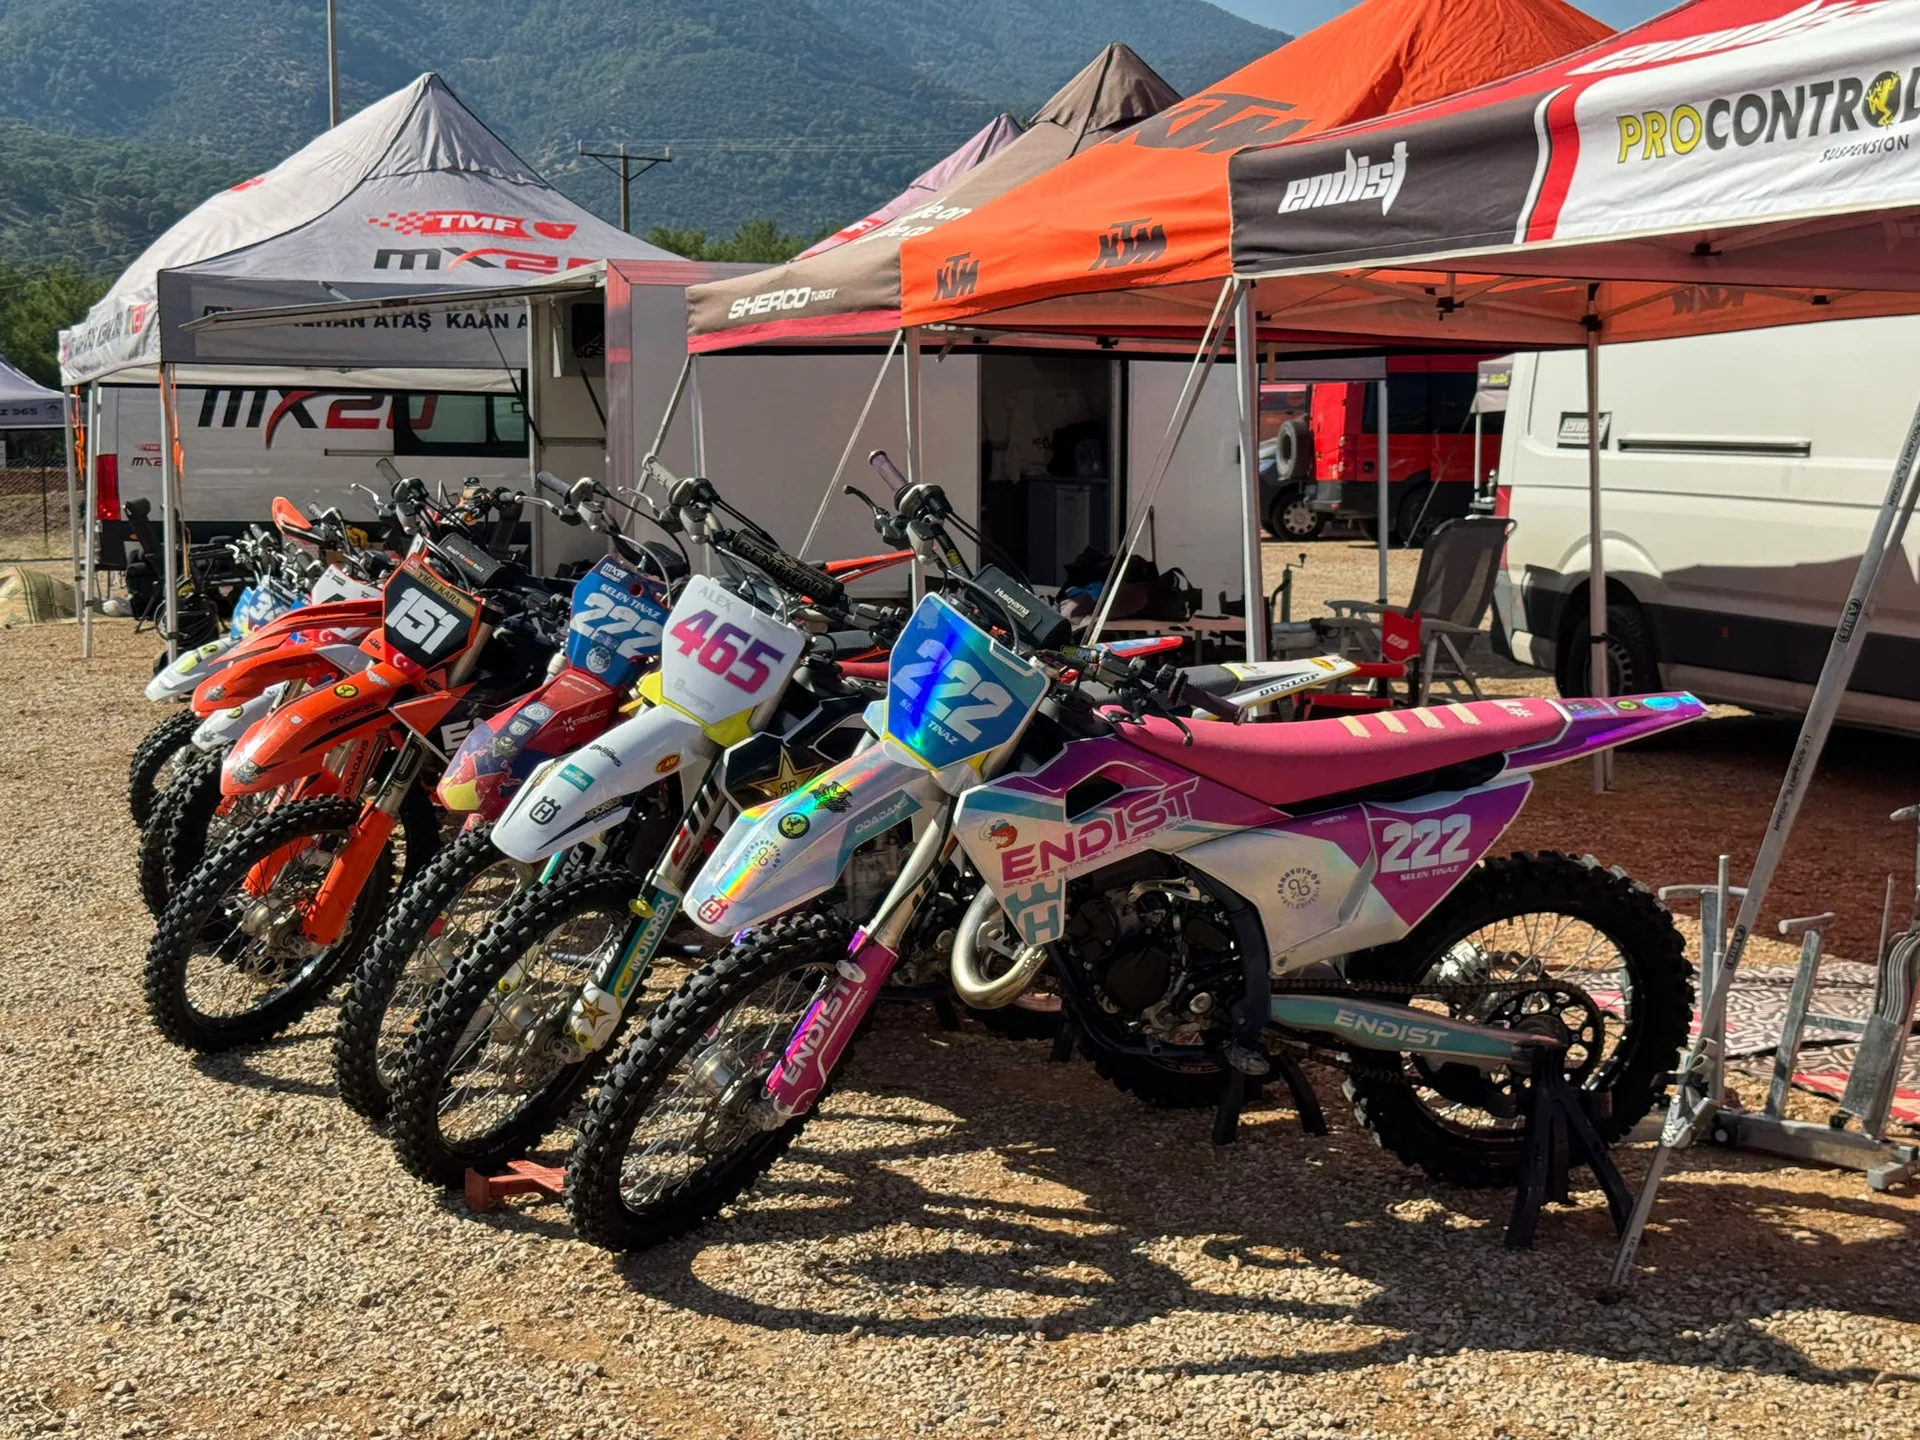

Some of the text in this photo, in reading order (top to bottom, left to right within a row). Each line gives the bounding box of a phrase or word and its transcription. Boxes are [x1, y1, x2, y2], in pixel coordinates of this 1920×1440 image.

[1818, 133, 1909, 164] SUSPENSION
[436, 214, 517, 232] TMF
[1088, 218, 1167, 271] KTM
[933, 251, 980, 301] KTM
[728, 286, 811, 320] SHERCO
[373, 312, 432, 333] ATAŞ
[446, 312, 509, 330] KAAN
[740, 538, 827, 597] RENTHAL
[599, 583, 661, 619] SELEN TINAZ
[698, 585, 736, 612] ALEX
[993, 586, 1031, 619] Husqvarna
[385, 587, 460, 655] 151
[569, 592, 664, 659] 222
[1839, 602, 1859, 640] ABUS
[670, 609, 786, 694] 465
[892, 638, 1014, 743] 222
[1259, 673, 1320, 697] DUNLOP
[927, 719, 960, 745] TINAZ
[344, 739, 370, 796] ODADANS
[585, 796, 623, 820] ROCKSTAR
[855, 799, 909, 833] ODADANS
[1001, 776, 1200, 882] ENDIST
[1380, 813, 1471, 873] 222
[1400, 865, 1459, 882] SELEN TINAZ
[630, 898, 674, 973] MOTOREX
[1726, 927, 1744, 965] ABUS
[782, 979, 851, 1086] ENDIST
[1333, 1008, 1450, 1047] ENDIST
